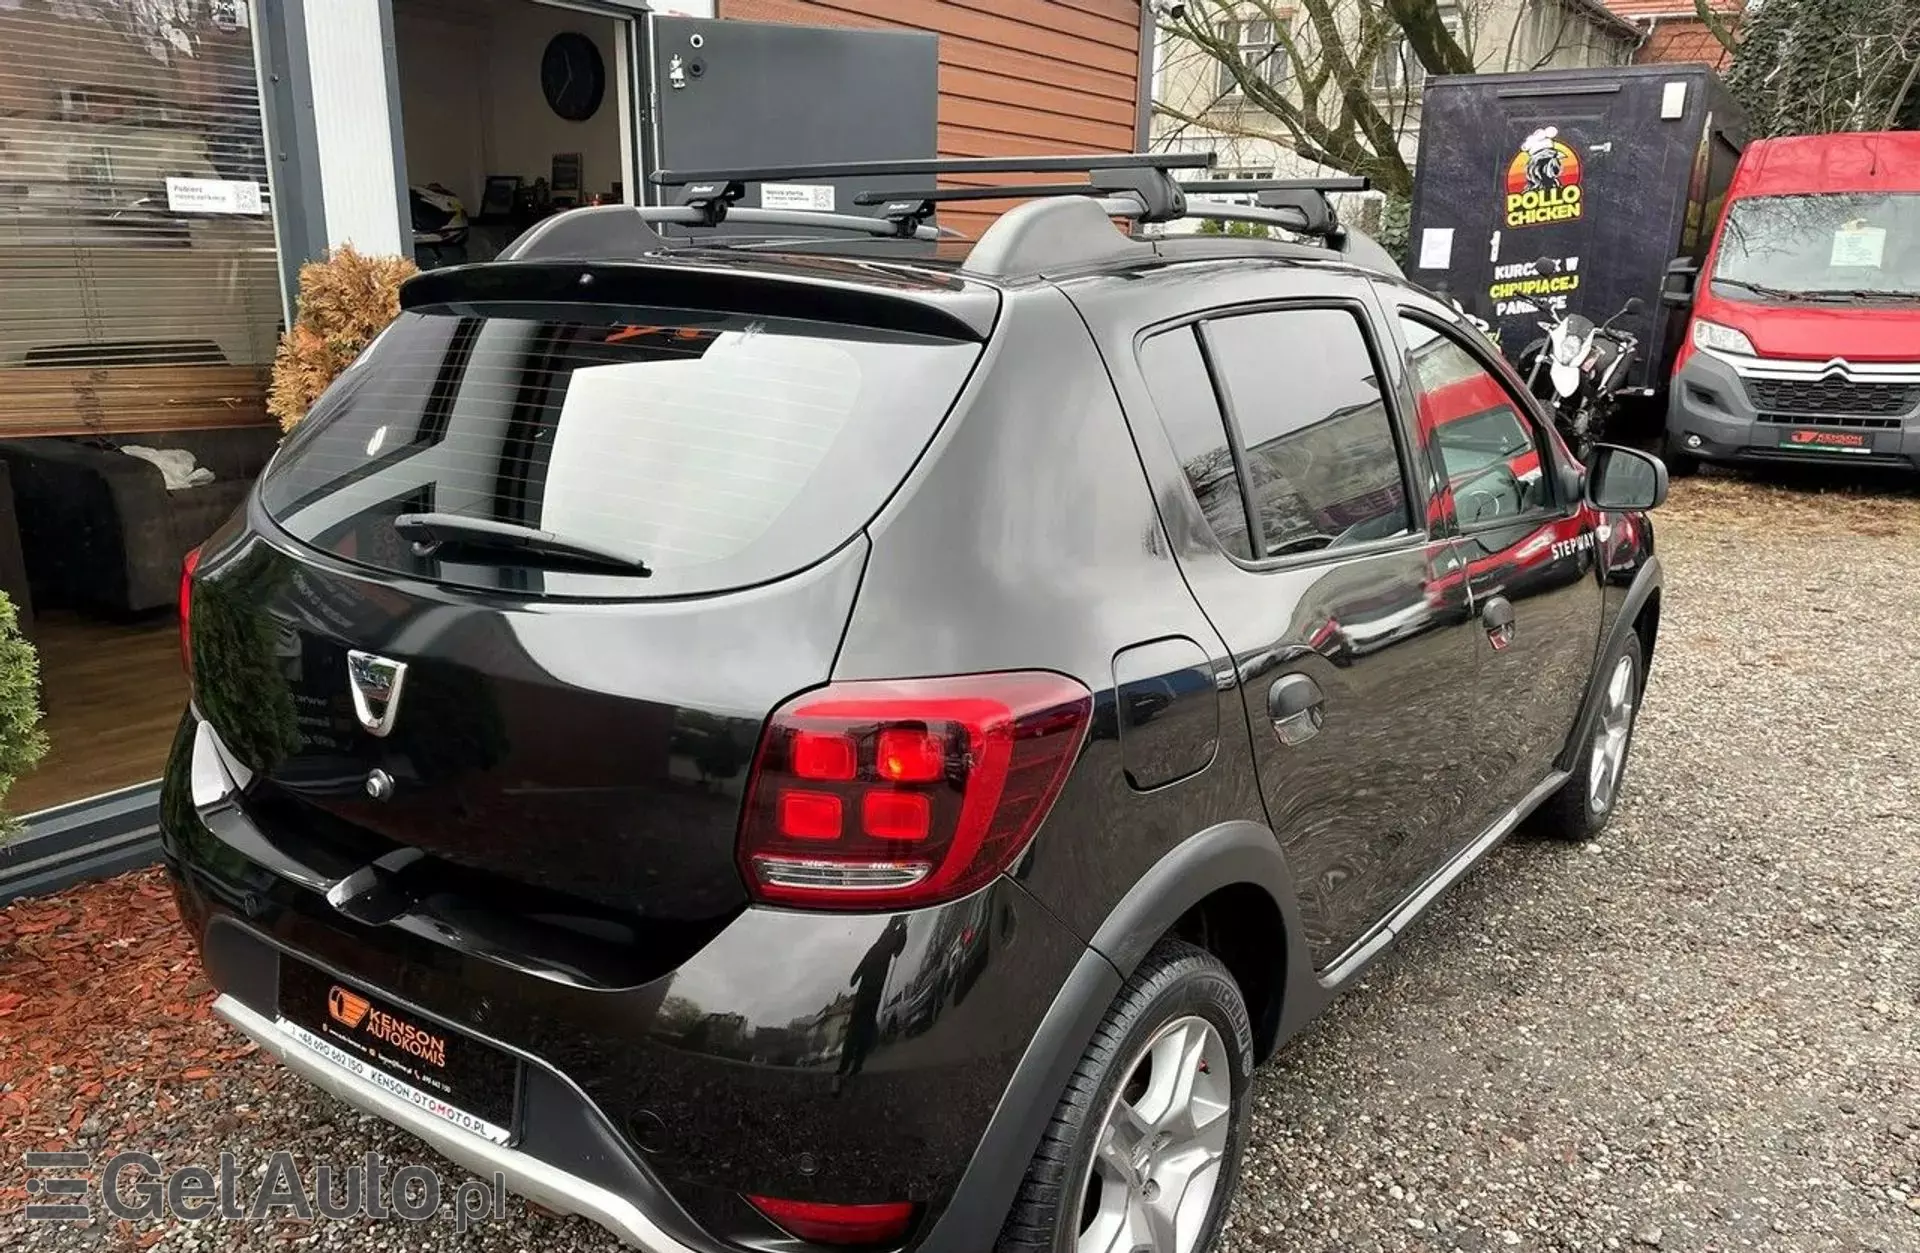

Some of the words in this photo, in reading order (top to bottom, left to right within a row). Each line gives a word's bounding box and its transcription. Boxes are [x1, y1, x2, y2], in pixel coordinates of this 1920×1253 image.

[1507, 184, 1580, 211] POLLO
[1507, 203, 1580, 226] CHICKEN
[1566, 256, 1579, 271] W
[1551, 531, 1595, 560] STEPWAY
[368, 1007, 445, 1054] KENSON
[366, 1023, 446, 1068] AUTOKOMIS
